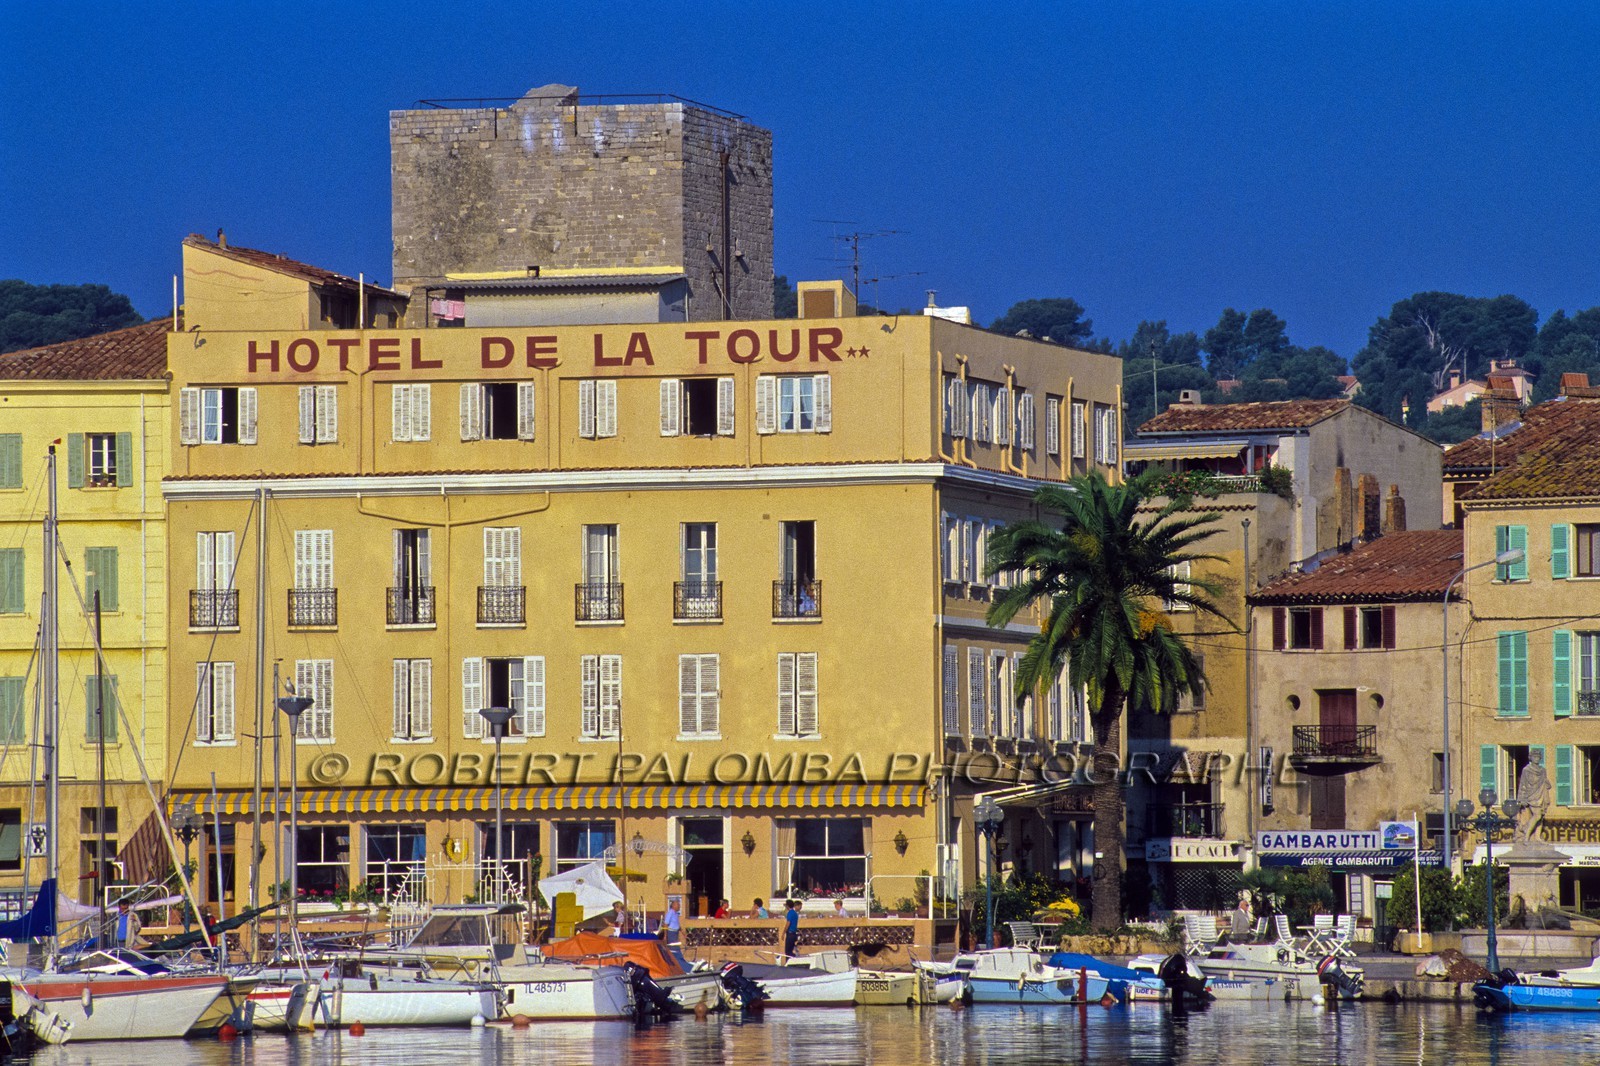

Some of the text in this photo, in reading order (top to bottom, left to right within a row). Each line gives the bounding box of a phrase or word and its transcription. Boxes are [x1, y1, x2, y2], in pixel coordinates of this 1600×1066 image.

[247, 327, 843, 373] HOTEL DE LA TOUR
[1261, 834, 1376, 848] GAMBARUTTI
[1301, 857, 1394, 866] AGENCE GAMBARUTTI
